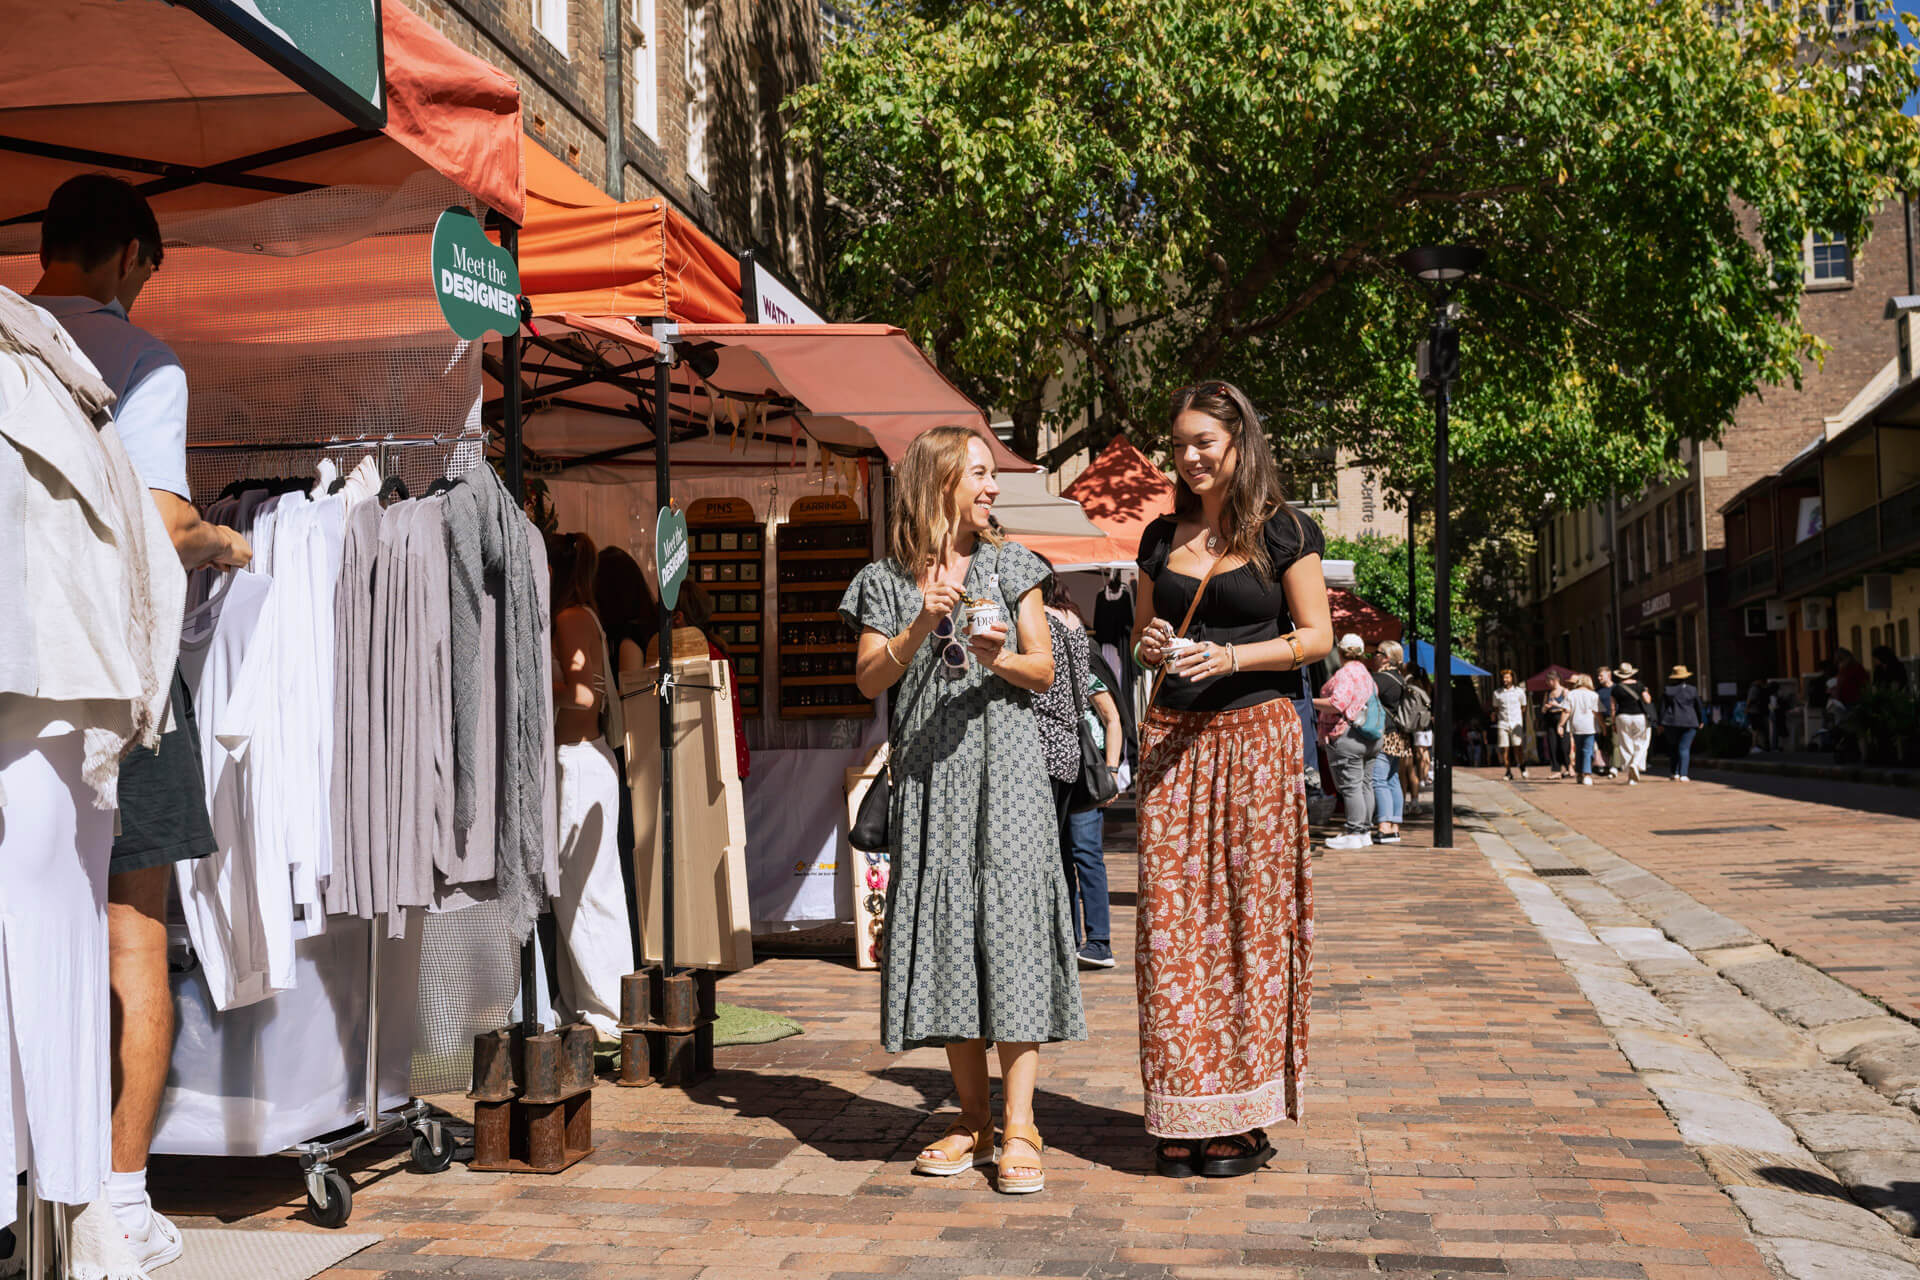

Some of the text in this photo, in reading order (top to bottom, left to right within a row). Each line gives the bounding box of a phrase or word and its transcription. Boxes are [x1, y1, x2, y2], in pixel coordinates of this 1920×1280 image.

[452, 243, 507, 286] Meet the
[441, 268, 517, 318] DESIGNER
[763, 295, 795, 324] WATT
[706, 503, 733, 513] PINS
[800, 501, 847, 512] EARRINGS
[663, 533, 677, 561] Meet
[661, 540, 688, 588] DESIGNER
